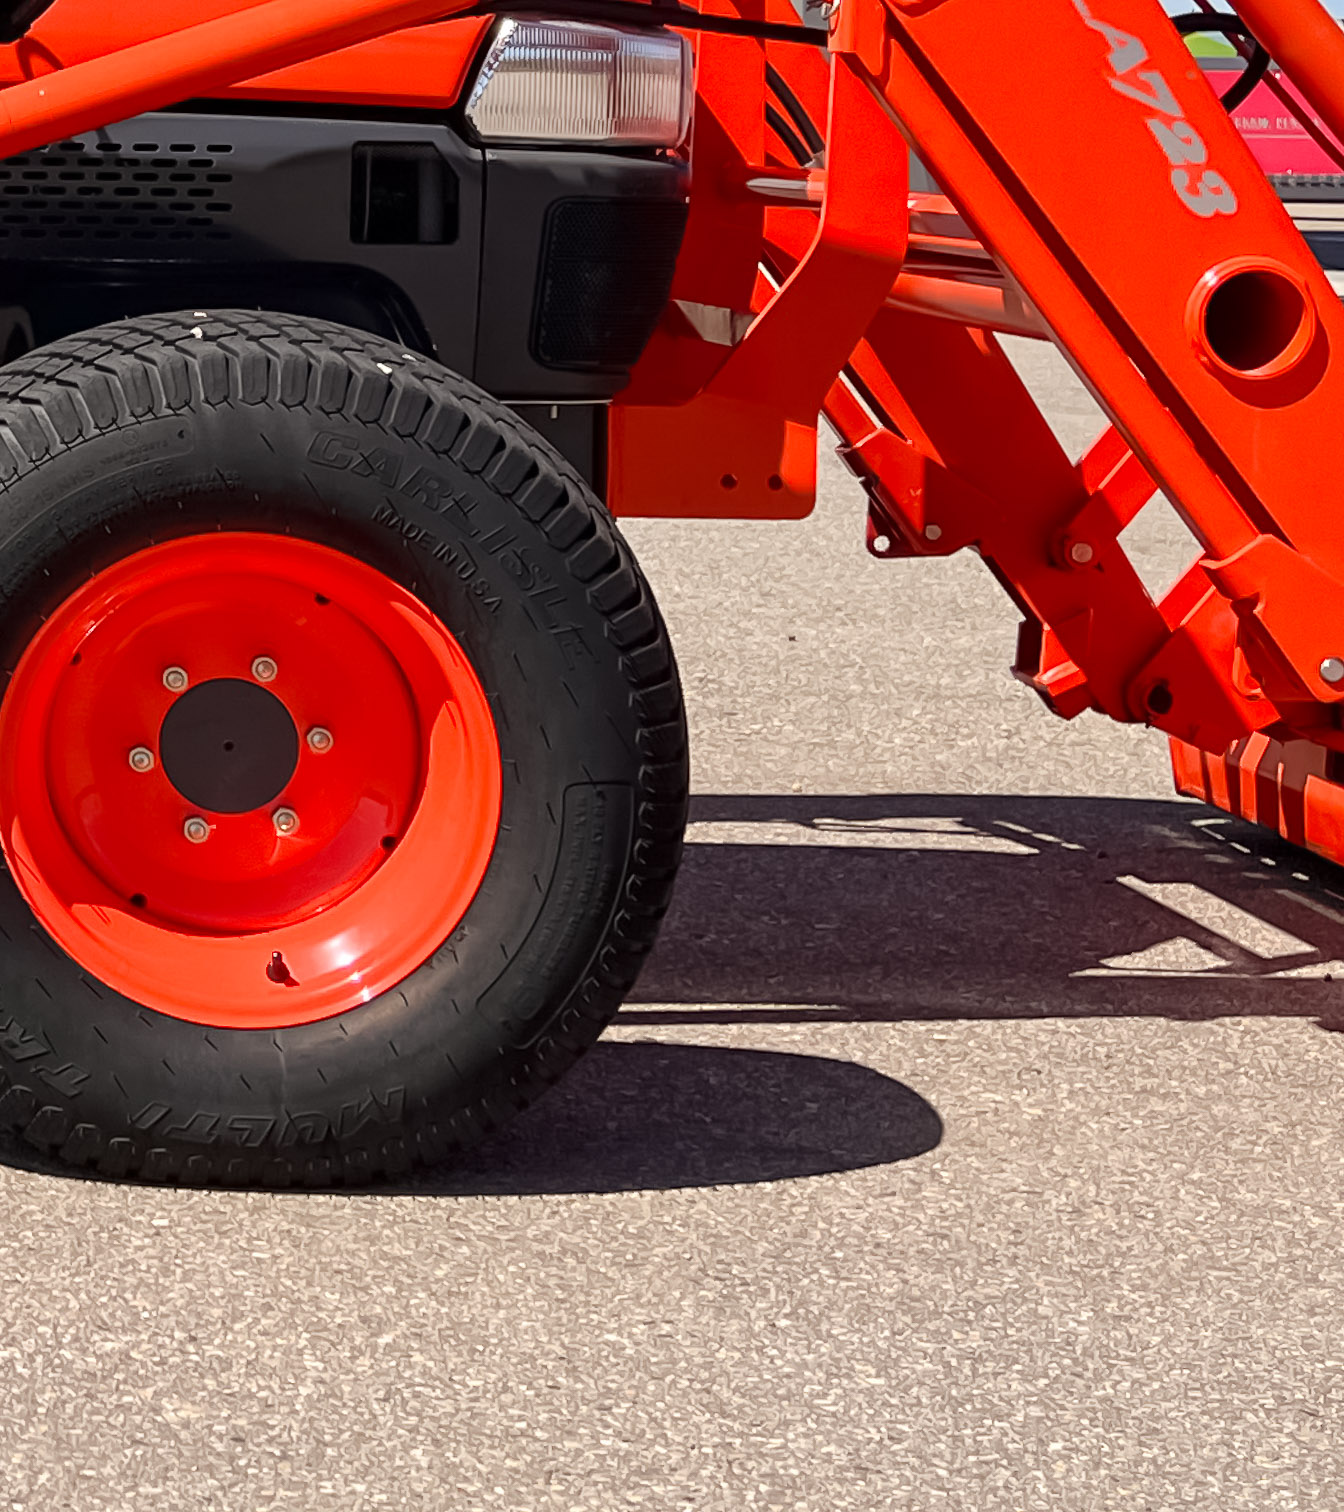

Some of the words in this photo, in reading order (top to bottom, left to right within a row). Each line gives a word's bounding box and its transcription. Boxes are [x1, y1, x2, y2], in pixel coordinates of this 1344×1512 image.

[309, 431, 599, 671] CARLISLE
[370, 504, 436, 550] MADE
[432, 541, 458, 566] IN
